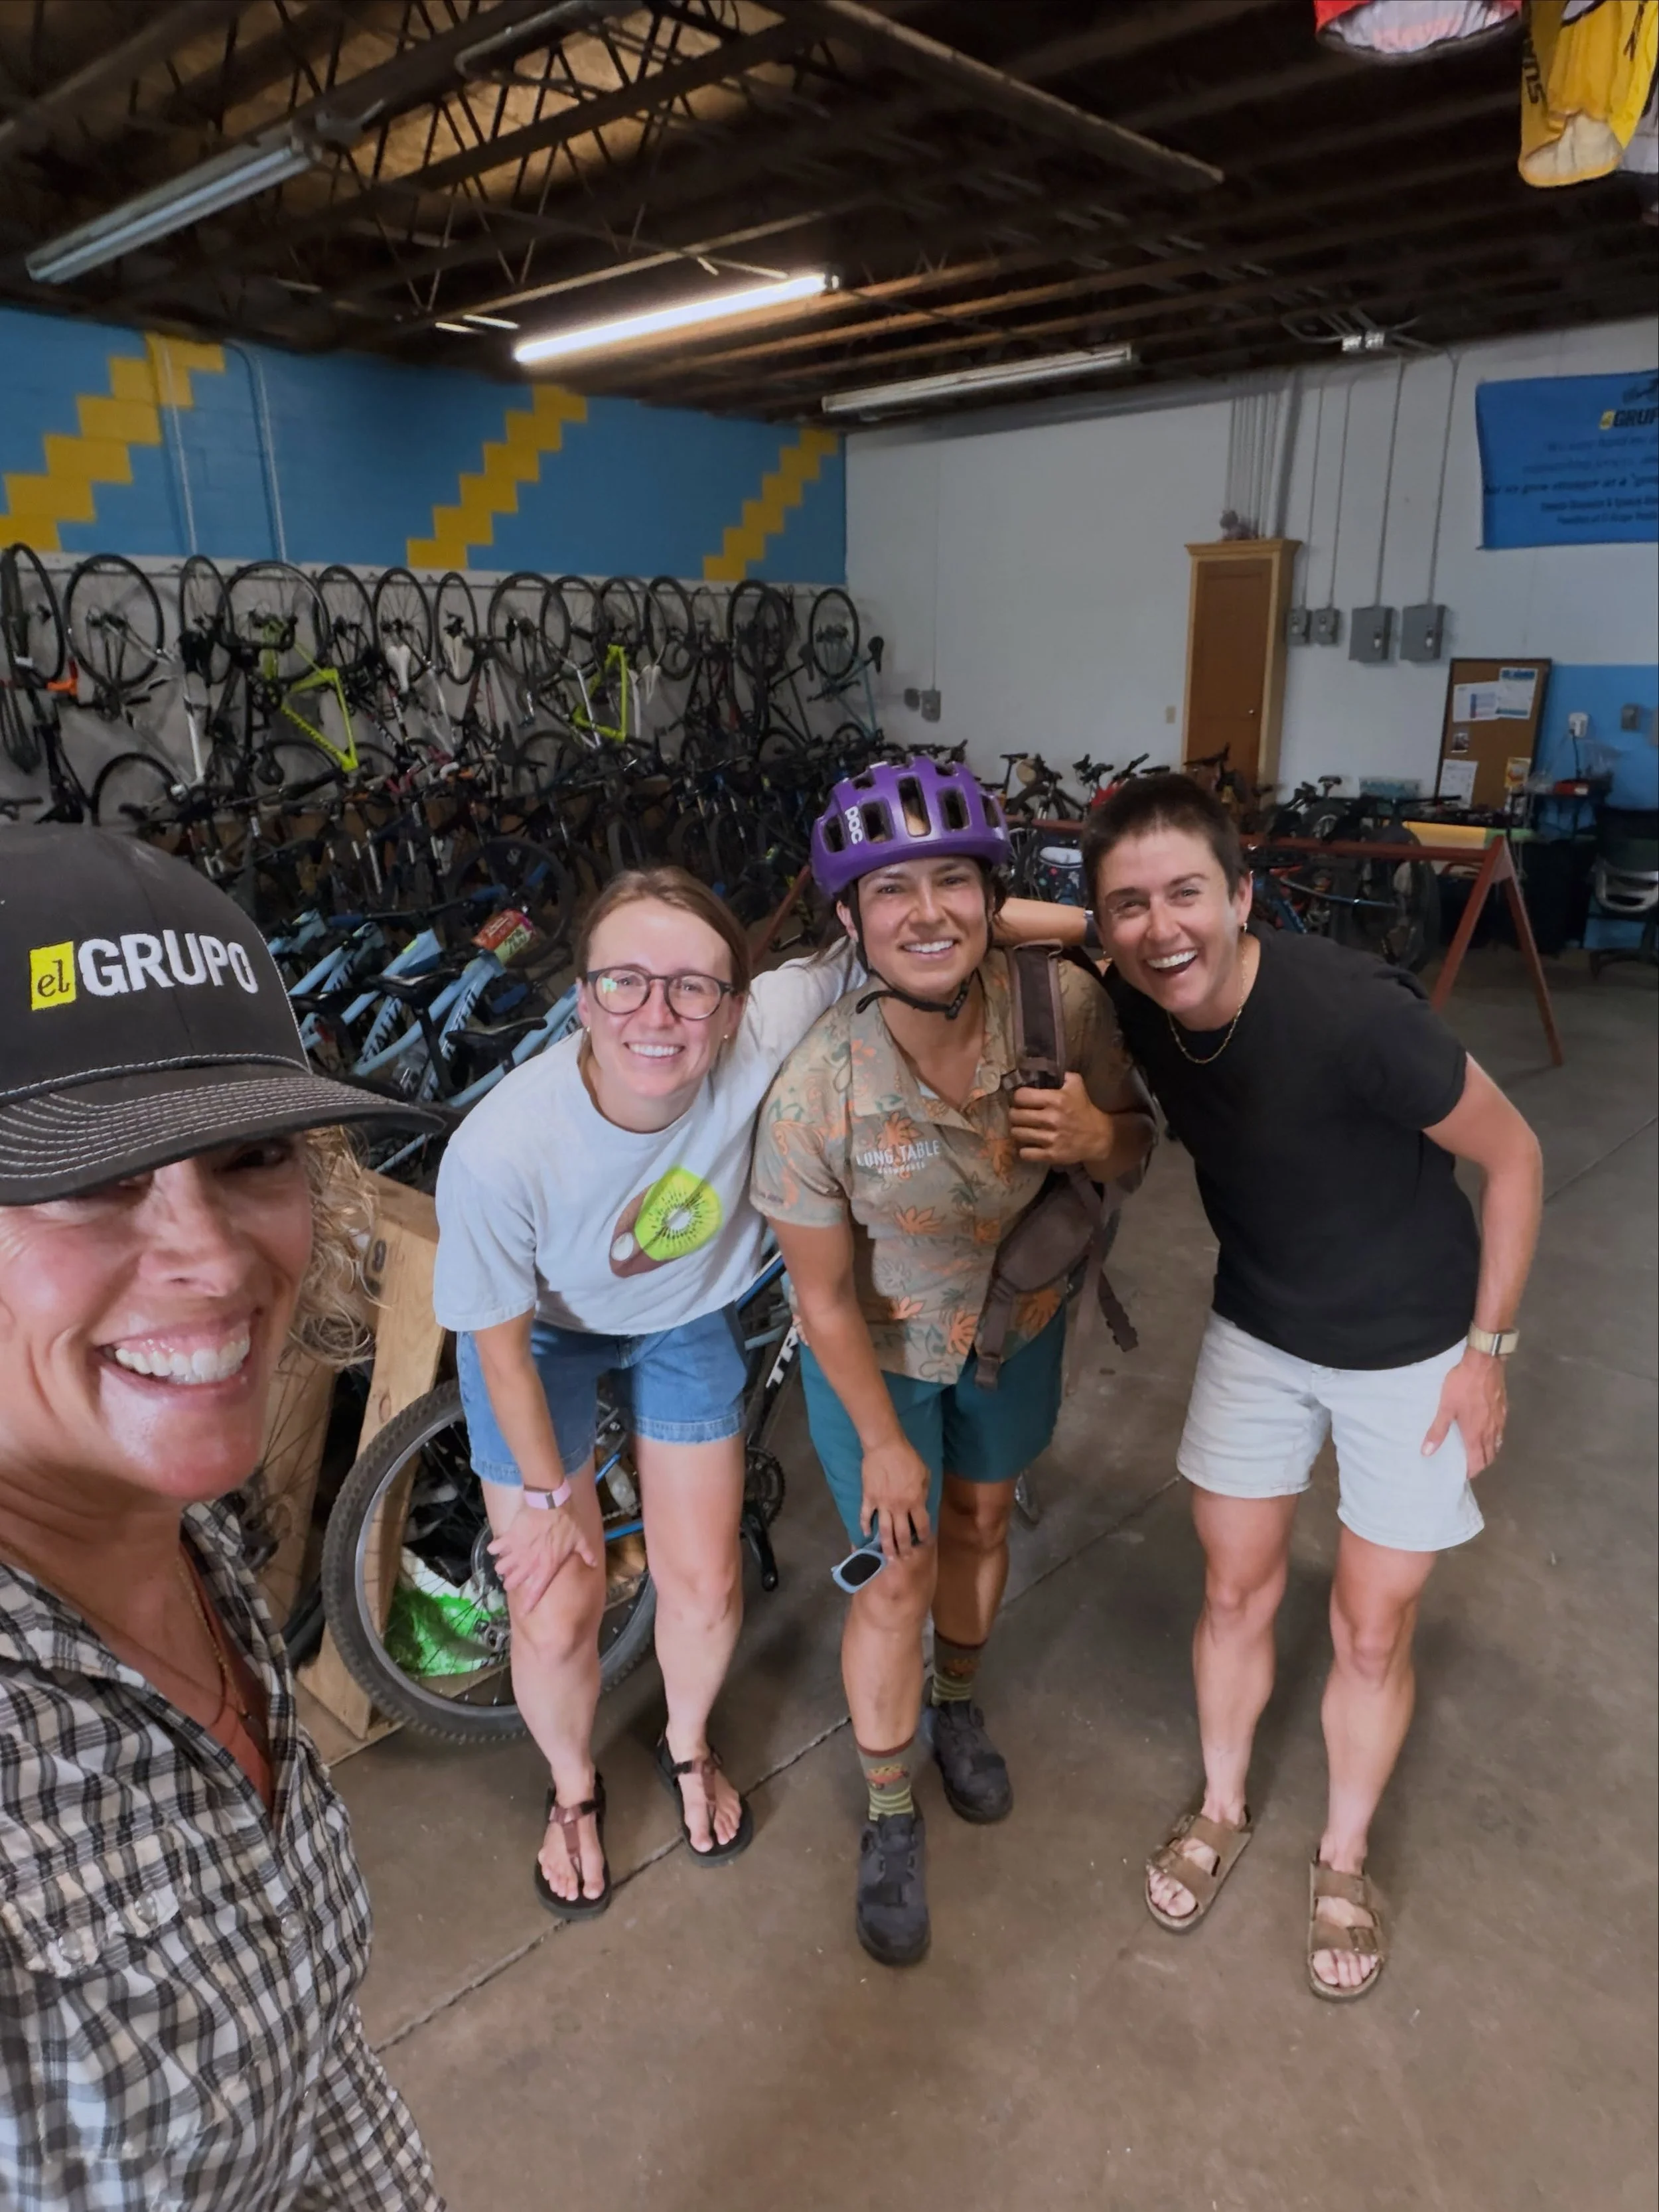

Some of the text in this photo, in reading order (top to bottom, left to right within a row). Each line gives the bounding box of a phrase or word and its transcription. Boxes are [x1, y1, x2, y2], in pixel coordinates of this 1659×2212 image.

[37, 930, 258, 997] el GRUPO
[856, 1140, 940, 1167] LONG TABLE
